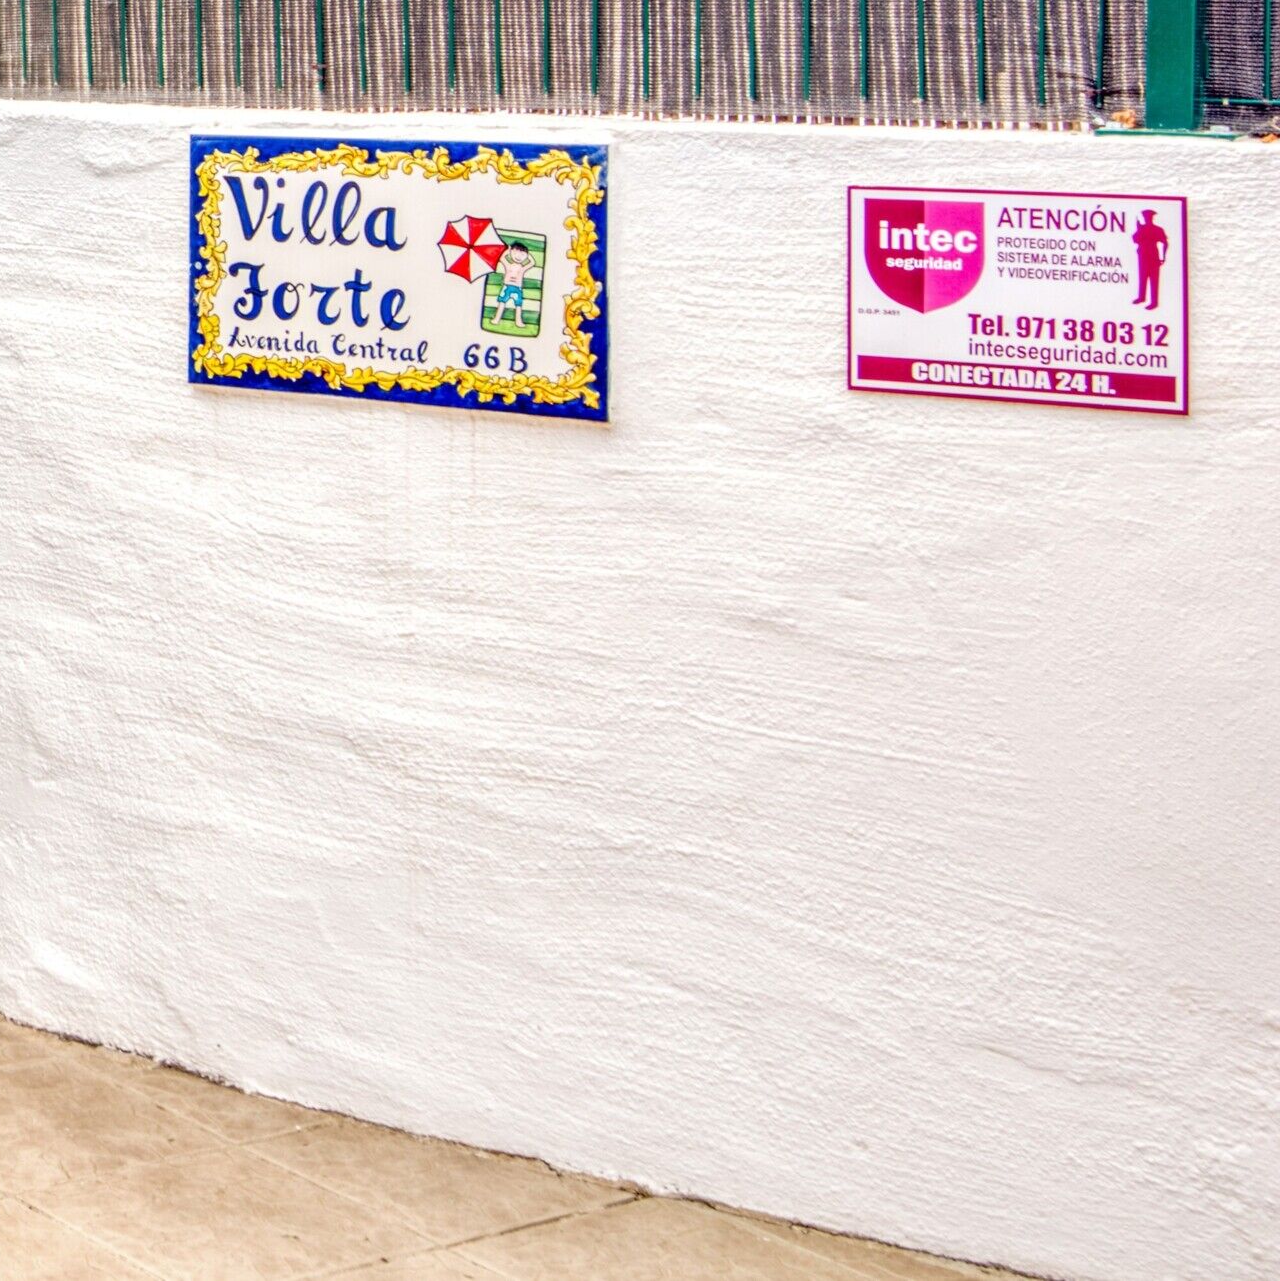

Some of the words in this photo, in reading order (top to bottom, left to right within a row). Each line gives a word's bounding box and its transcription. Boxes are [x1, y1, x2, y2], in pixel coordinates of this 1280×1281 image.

[223, 175, 408, 252] Villa
[997, 205, 1127, 233] ATENCIÓN
[879, 220, 978, 254] intec
[997, 237, 1067, 251] PROTEGIDO
[1069, 240, 1096, 251] CON
[886, 256, 963, 272] seguridad
[997, 252, 1050, 265] SISTEMA
[1052, 255, 1069, 266] DE
[1071, 255, 1122, 268] ALARMA
[997, 267, 1006, 278] Y
[1008, 267, 1129, 284] VIDEOVERIFICACIÓN
[968, 313, 1010, 338] Tel.
[1016, 317, 1056, 341] 971
[1063, 319, 1095, 343] 38
[1103, 321, 1135, 345] 03
[1142, 323, 1169, 347] 12
[228, 327, 321, 354] Avenida
[332, 333, 429, 364] Central
[969, 338, 1168, 368] intecseguridad.com
[911, 361, 1053, 392] CONECTADA
[1055, 373, 1088, 393] 24
[1092, 376, 1117, 395] H.
